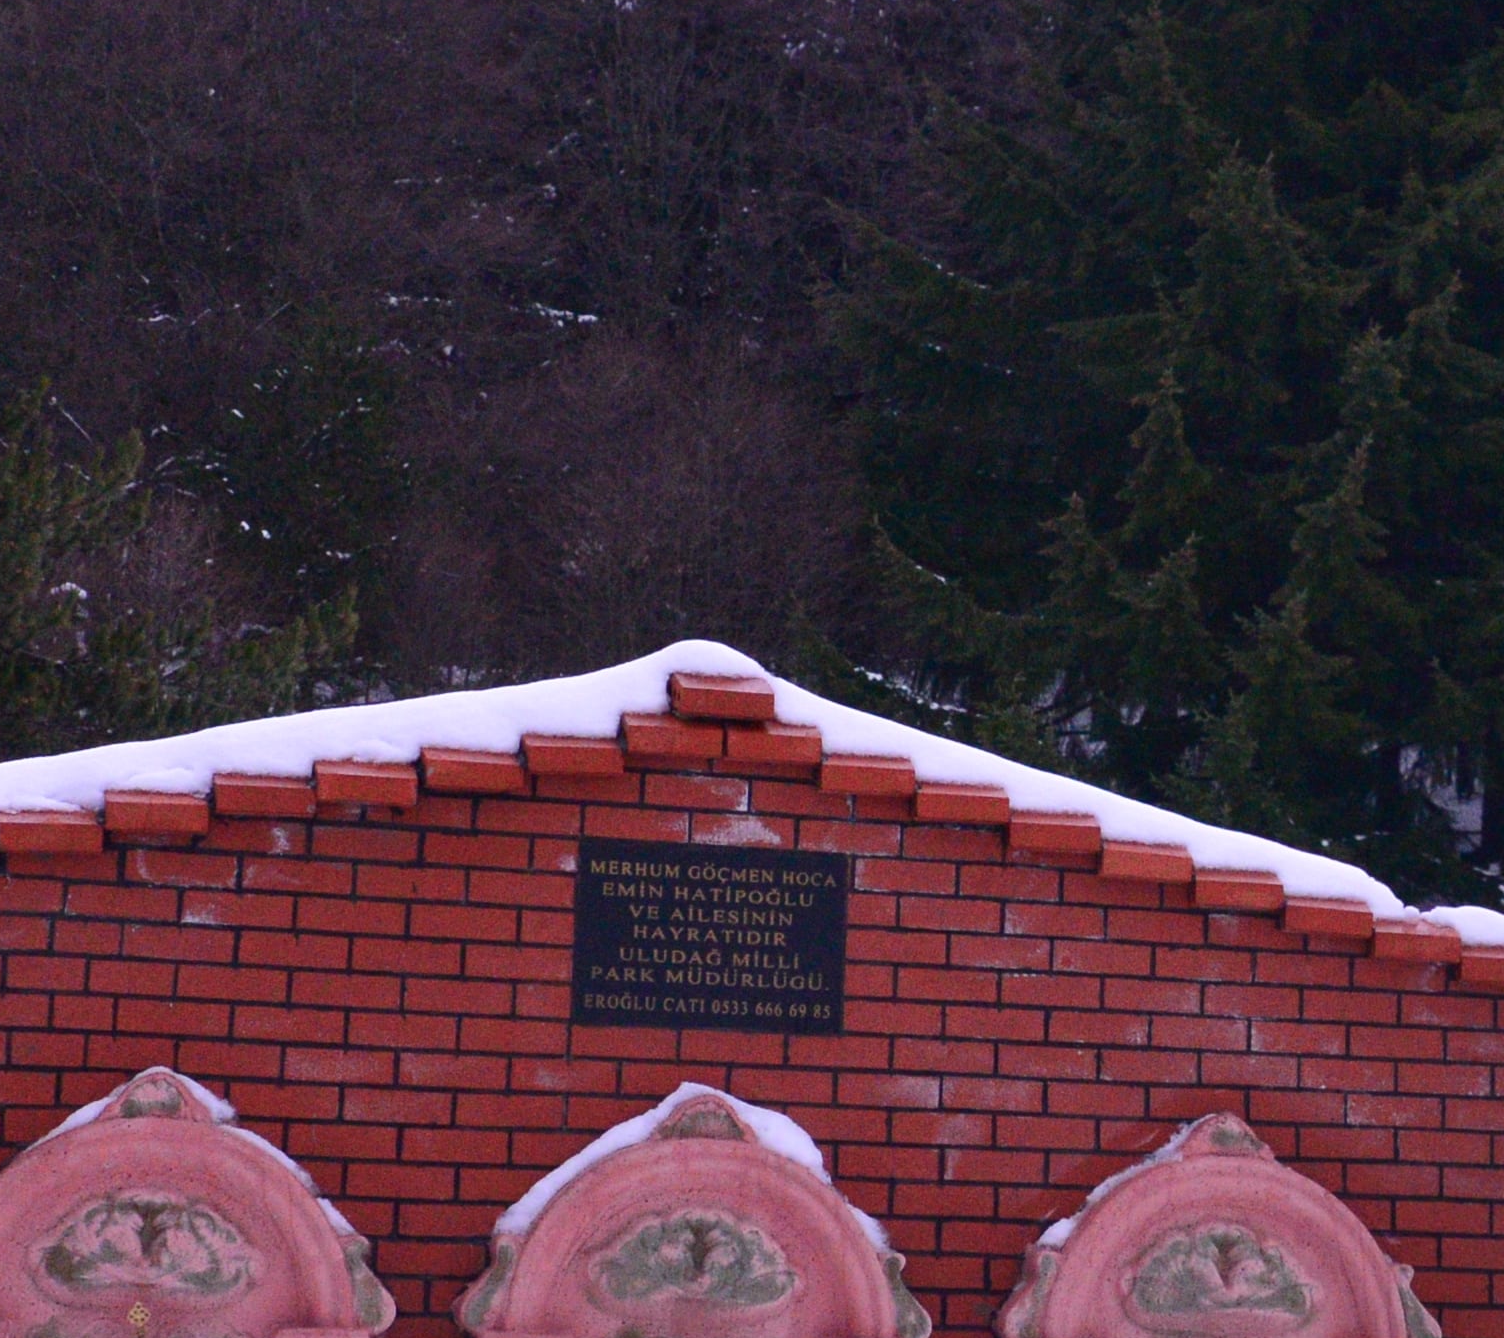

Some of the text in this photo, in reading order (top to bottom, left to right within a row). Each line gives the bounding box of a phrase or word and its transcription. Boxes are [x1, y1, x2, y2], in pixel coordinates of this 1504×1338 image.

[591, 860, 836, 887] MERHUM GÖÇMEN HOCA
[603, 880, 814, 907] EMİN HATİPOĞLU
[629, 905, 793, 926] VE AİLESİNİN
[633, 925, 786, 946] HAYRATIDIR
[619, 947, 799, 969] ULUDAĞ MİLLİ
[591, 965, 655, 982] PARK
[584, 992, 656, 1011] EROĞLU
[711, 1000, 748, 1015] 0533
[755, 1002, 783, 1017] 666
[789, 1004, 807, 1017] 69
[813, 1005, 831, 1019] 85
